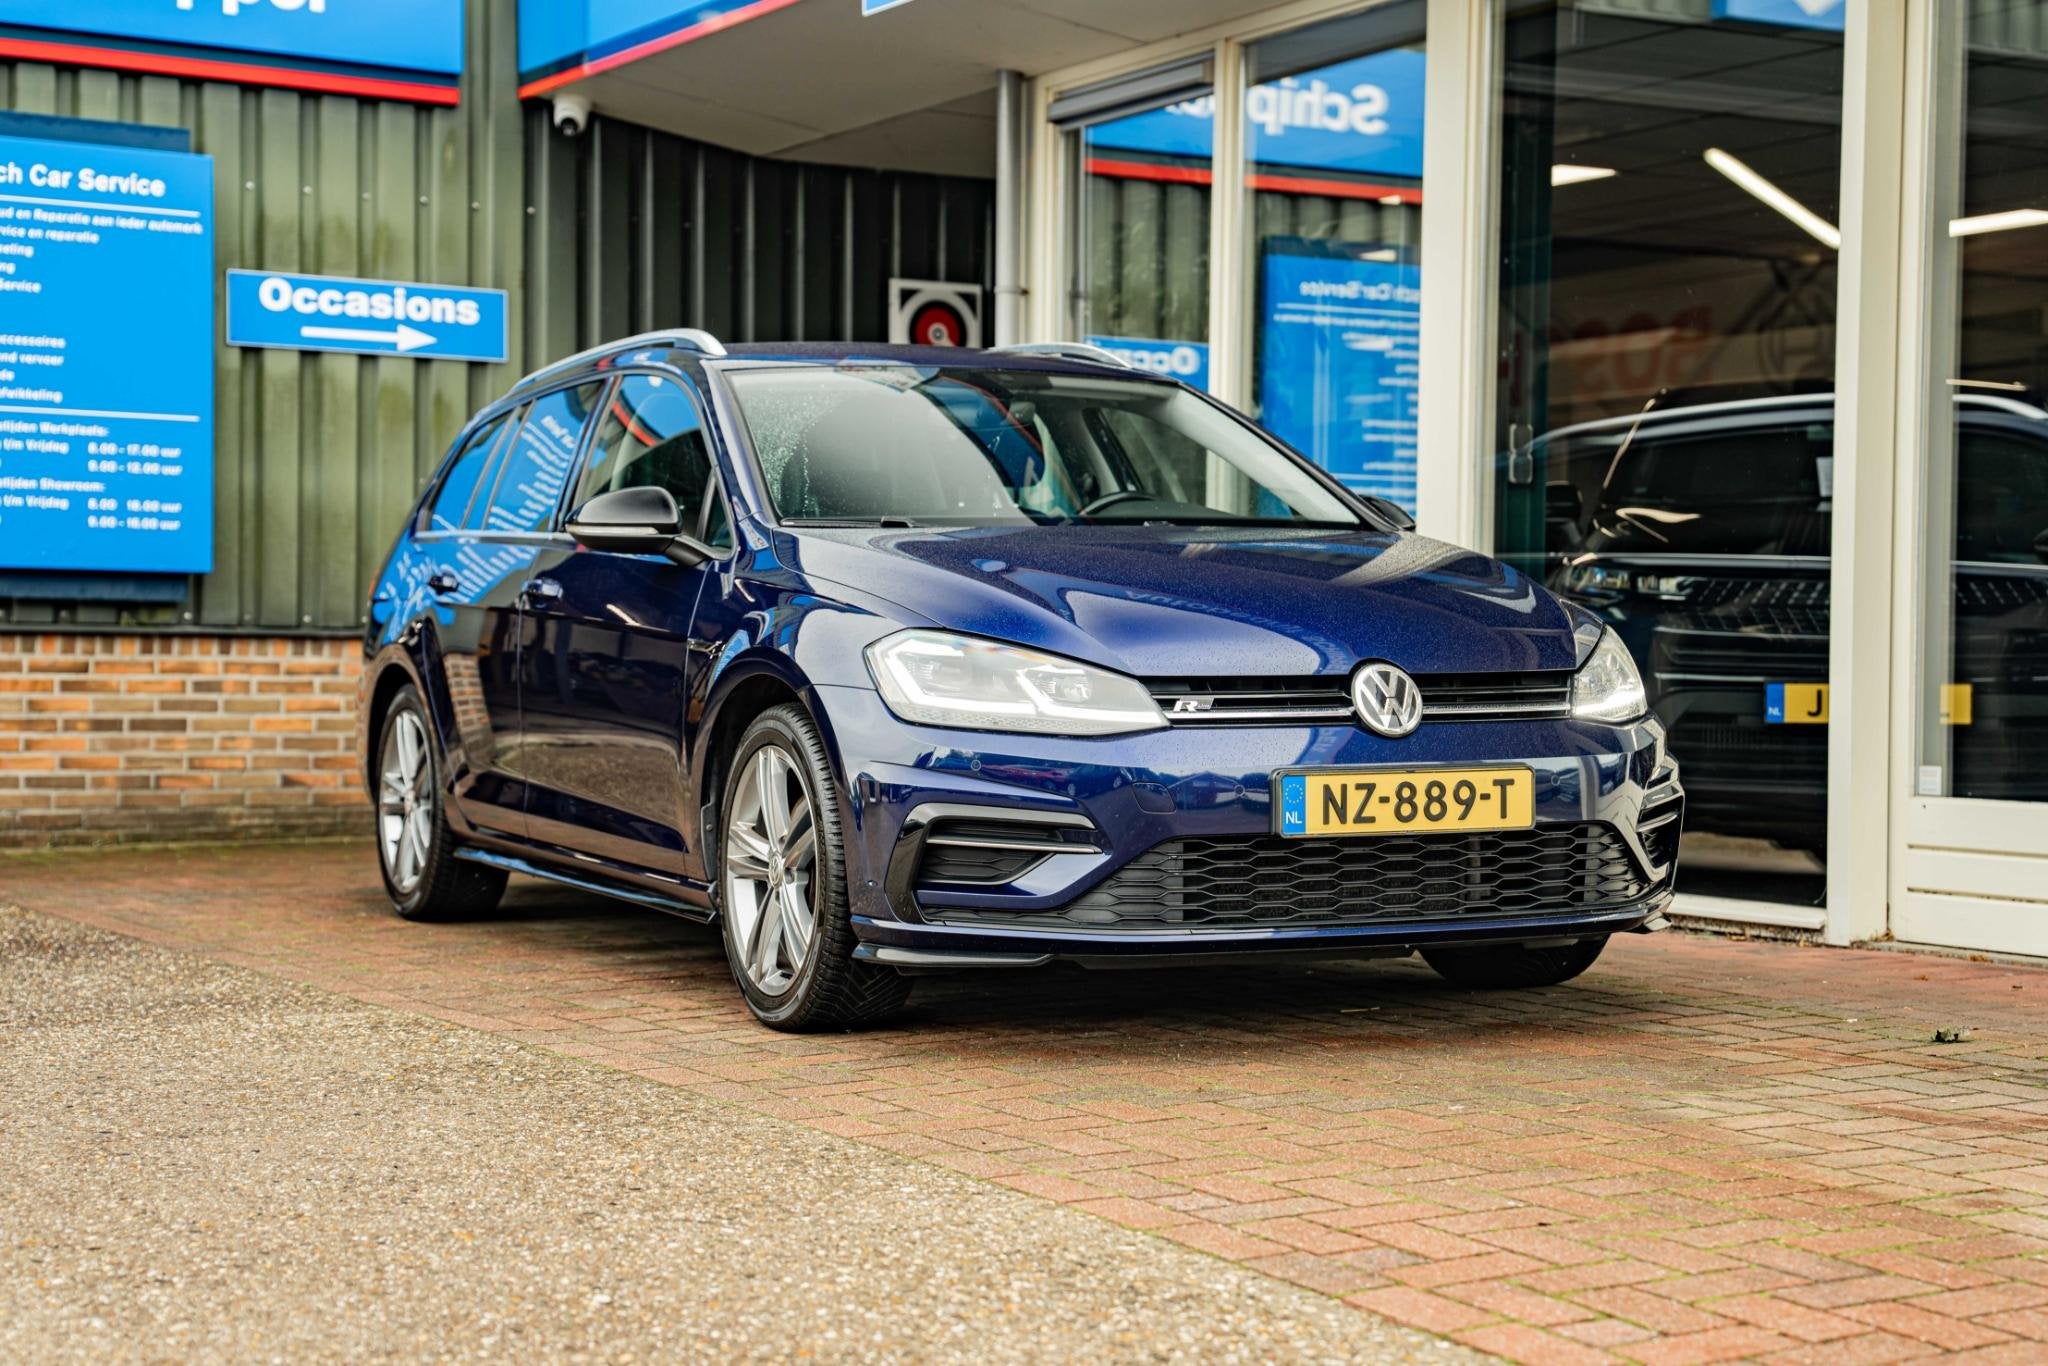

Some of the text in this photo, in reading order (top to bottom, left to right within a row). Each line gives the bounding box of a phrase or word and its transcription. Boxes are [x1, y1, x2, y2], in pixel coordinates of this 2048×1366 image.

[29, 163, 73, 188] Car
[78, 168, 167, 198] Service
[258, 276, 481, 326] Occasions
[1767, 706, 1782, 717] NL
[1285, 811, 1303, 825] NL
[1322, 778, 1515, 825] NZ-889-T
